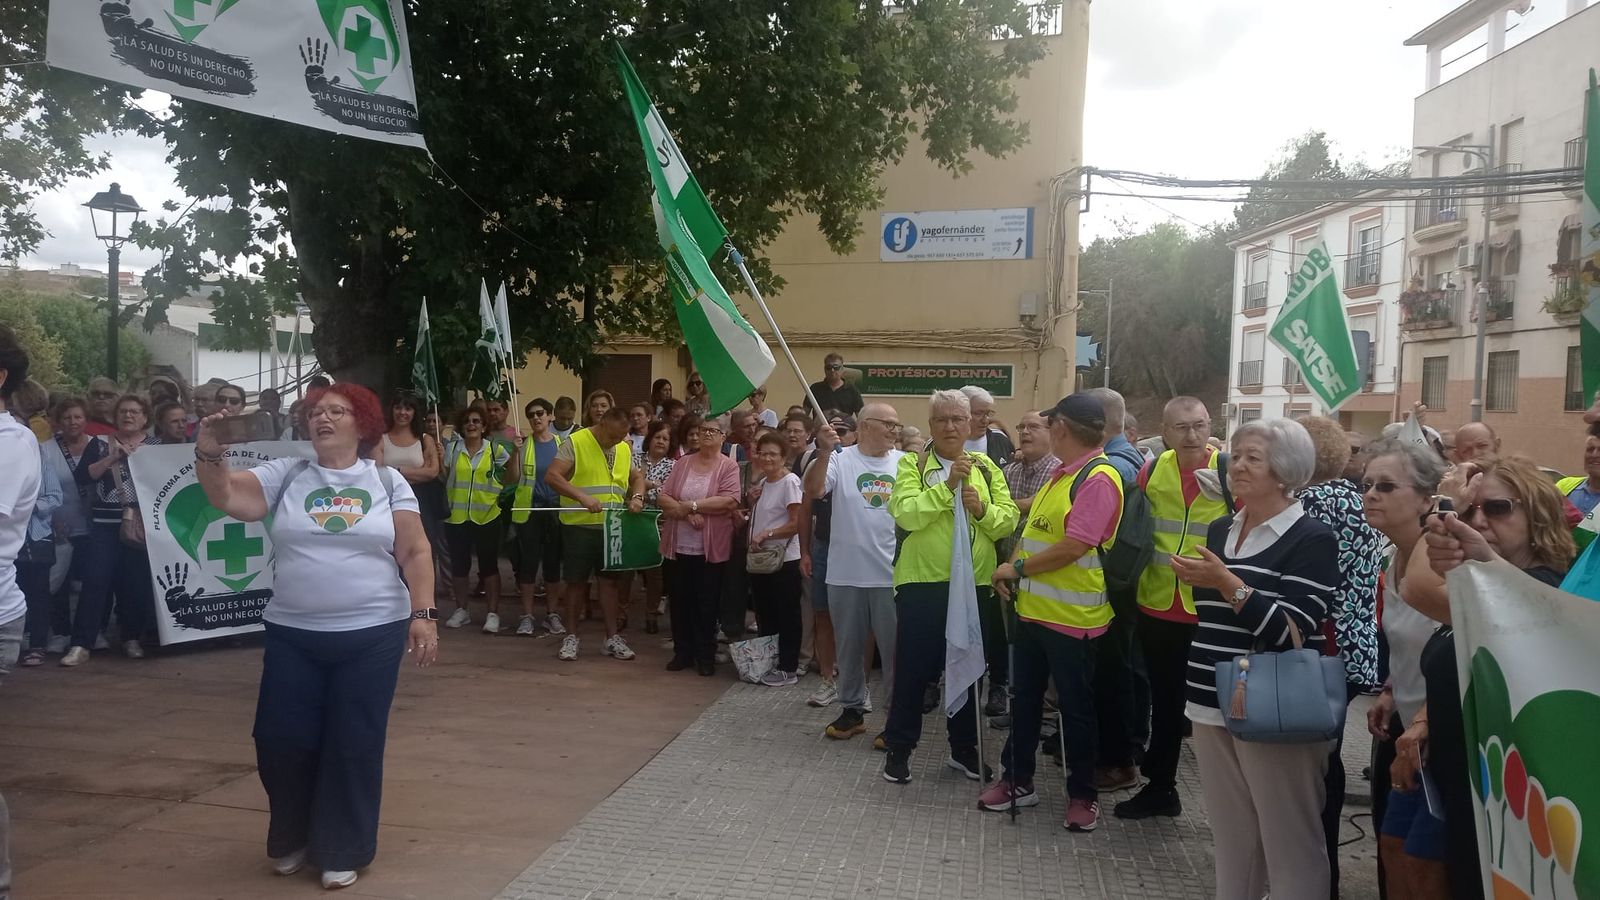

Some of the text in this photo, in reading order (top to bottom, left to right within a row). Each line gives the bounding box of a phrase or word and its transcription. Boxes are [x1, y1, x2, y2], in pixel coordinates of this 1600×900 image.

[120, 35, 248, 80] ¡LA SALUD ES UN DERECHO,
[150, 58, 227, 87] NO UN NEGOCIO!
[333, 94, 360, 107] SALUD
[361, 100, 371, 110] ES
[373, 103, 385, 113] UN
[341, 108, 407, 128] NO UN NEGOCIO!
[1283, 318, 1348, 401] SATSE
[867, 367, 1008, 379] PROTÉSICO DENTAL
[241, 450, 255, 459] DE
[257, 453, 269, 462] LA
[152, 463, 194, 531] PLATAFORMA EN
[195, 602, 226, 614] SALUD
[227, 600, 239, 609] ES
[242, 598, 255, 608] UN
[204, 615, 218, 623] NO
[220, 612, 233, 621] UN
